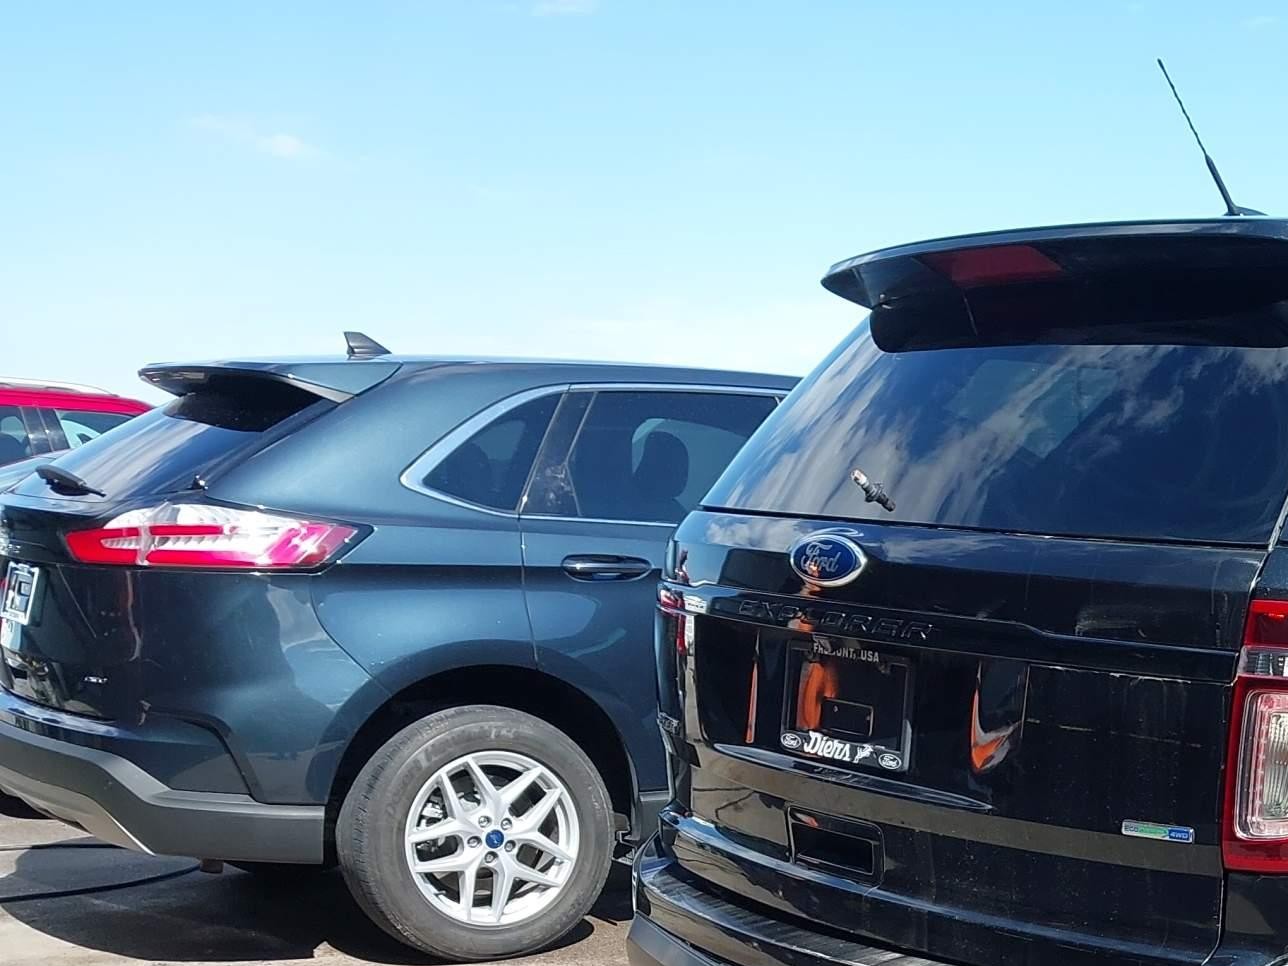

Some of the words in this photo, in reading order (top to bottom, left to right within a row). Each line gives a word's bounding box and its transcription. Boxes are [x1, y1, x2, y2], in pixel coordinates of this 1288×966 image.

[801, 541, 841, 574] Ford
[738, 599, 936, 640] EXPORER
[812, 642, 857, 661] FRONT,
[860, 648, 880, 663] USA
[803, 731, 851, 762] Diers
